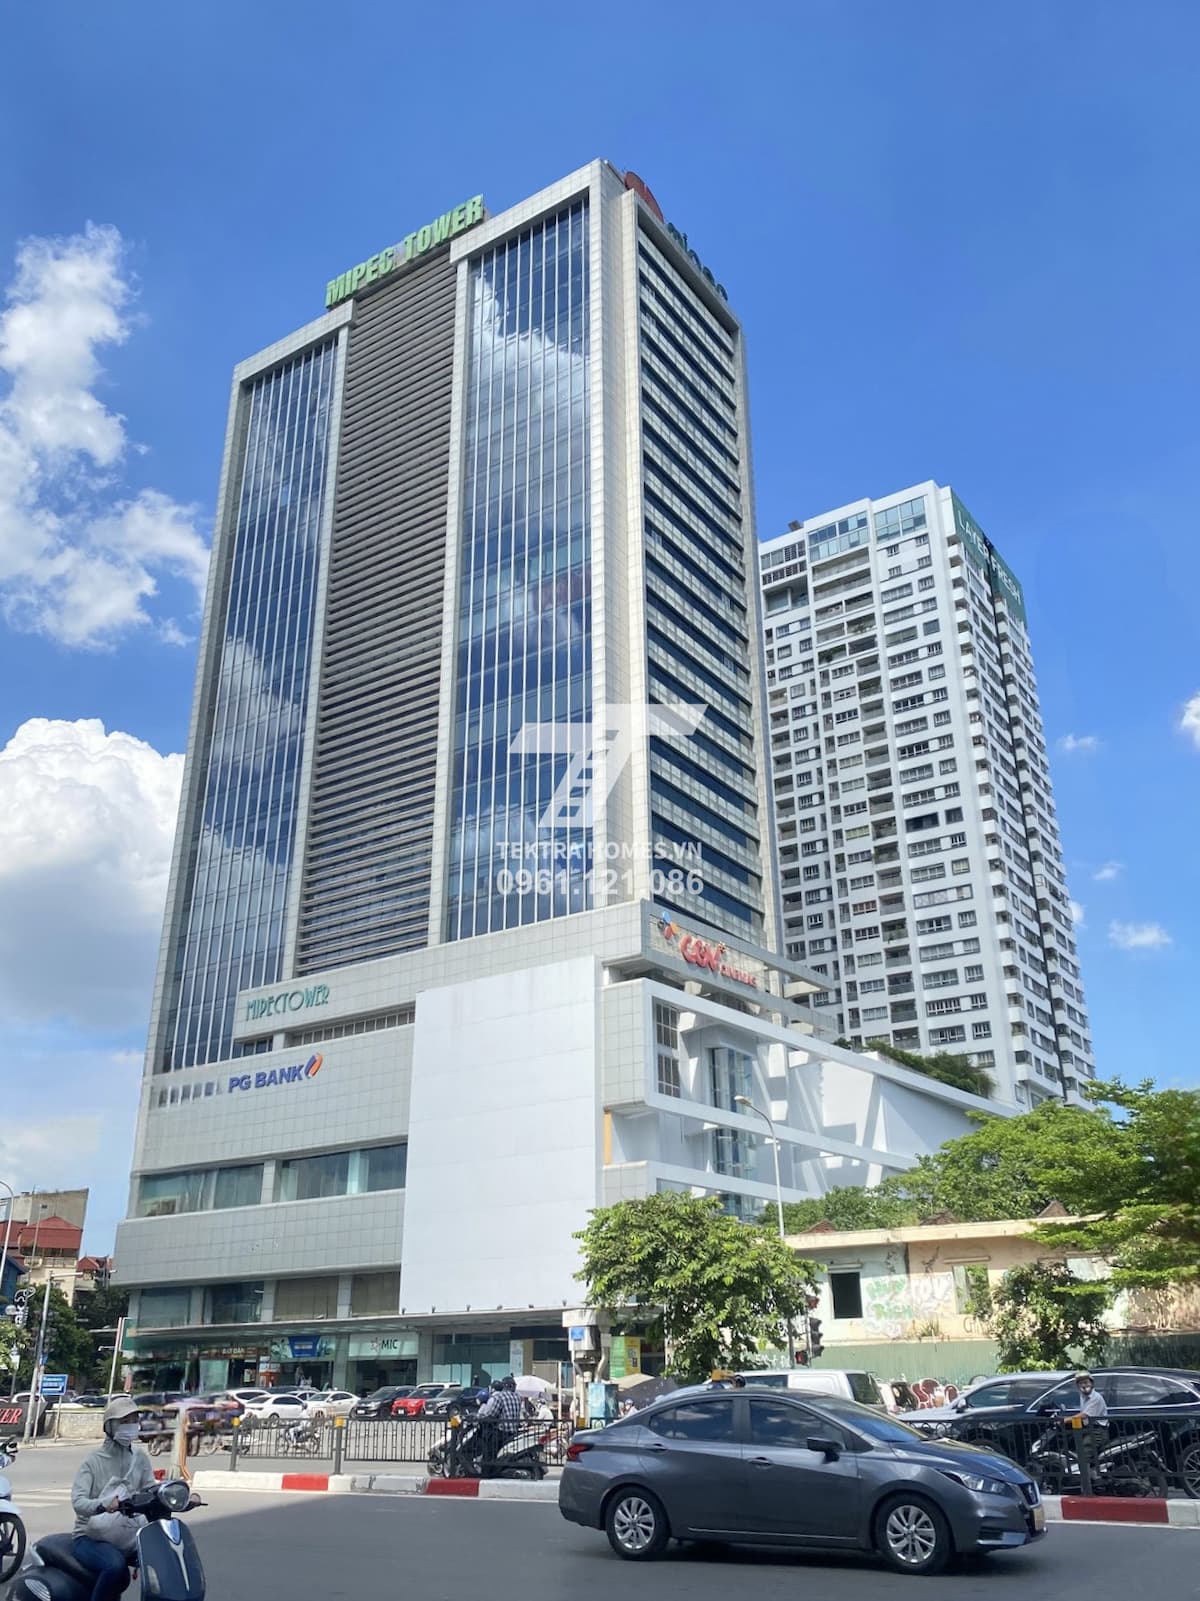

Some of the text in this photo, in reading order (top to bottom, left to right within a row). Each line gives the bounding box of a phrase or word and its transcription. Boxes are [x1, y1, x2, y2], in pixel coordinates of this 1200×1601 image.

[326, 194, 484, 308] MIPEC TOWER
[228, 1064, 305, 1093] PG BANK
[381, 1338, 399, 1350] MIC
